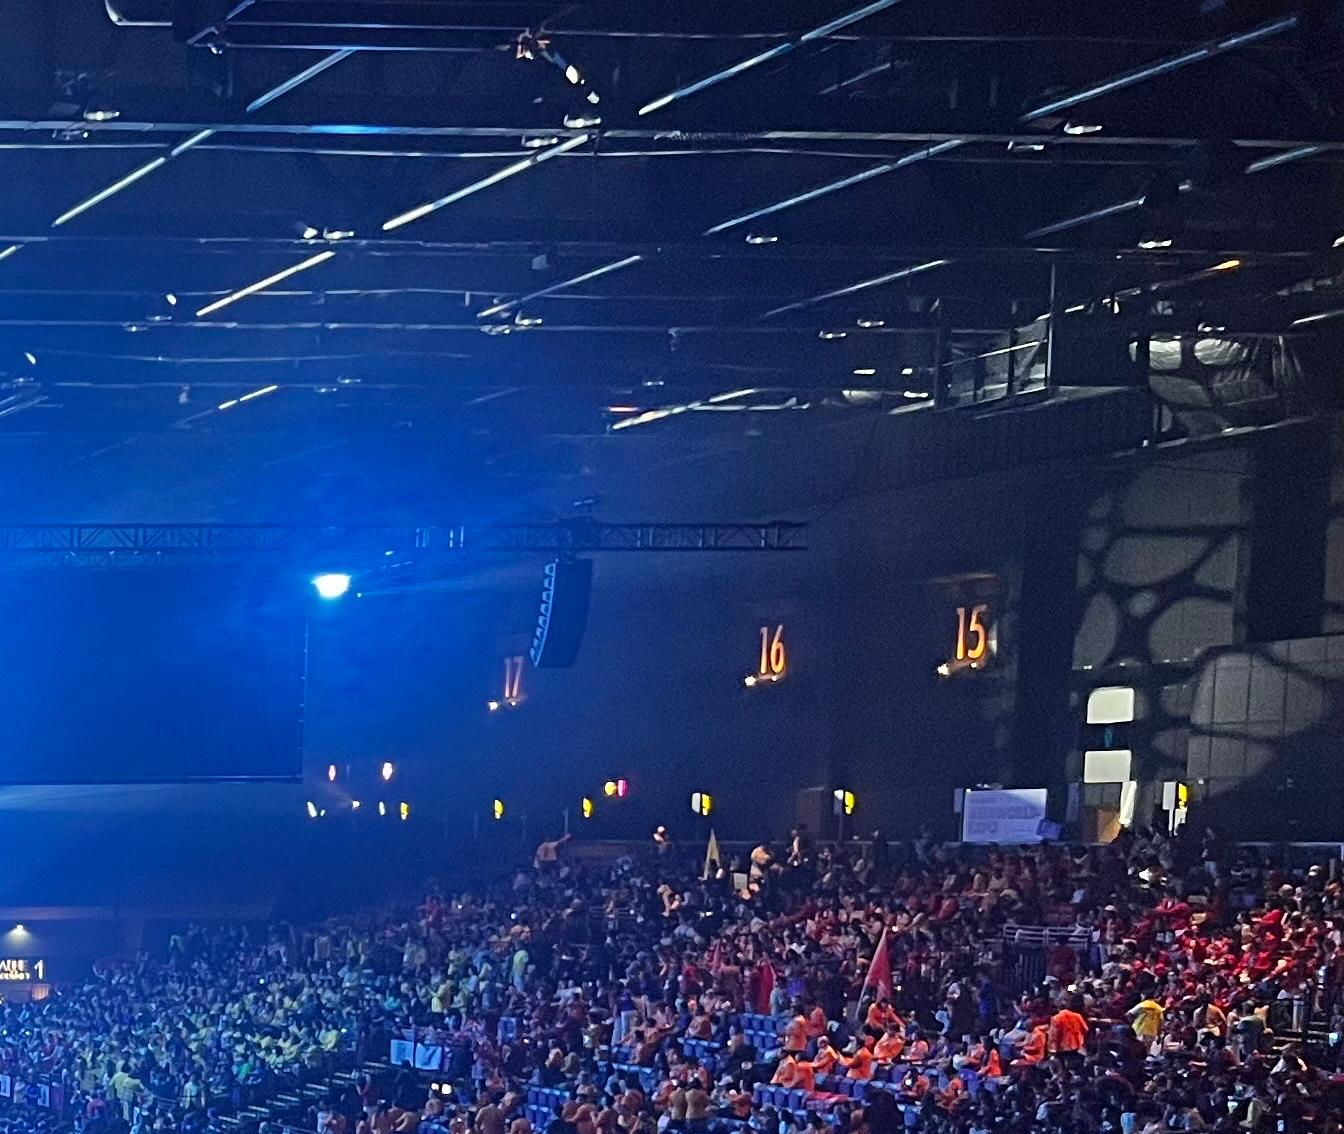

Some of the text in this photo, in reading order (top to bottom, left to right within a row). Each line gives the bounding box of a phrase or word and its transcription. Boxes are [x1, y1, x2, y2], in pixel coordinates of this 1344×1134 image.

[760, 624, 785, 674] 16
[955, 603, 987, 660] 15
[504, 655, 523, 698] 17
